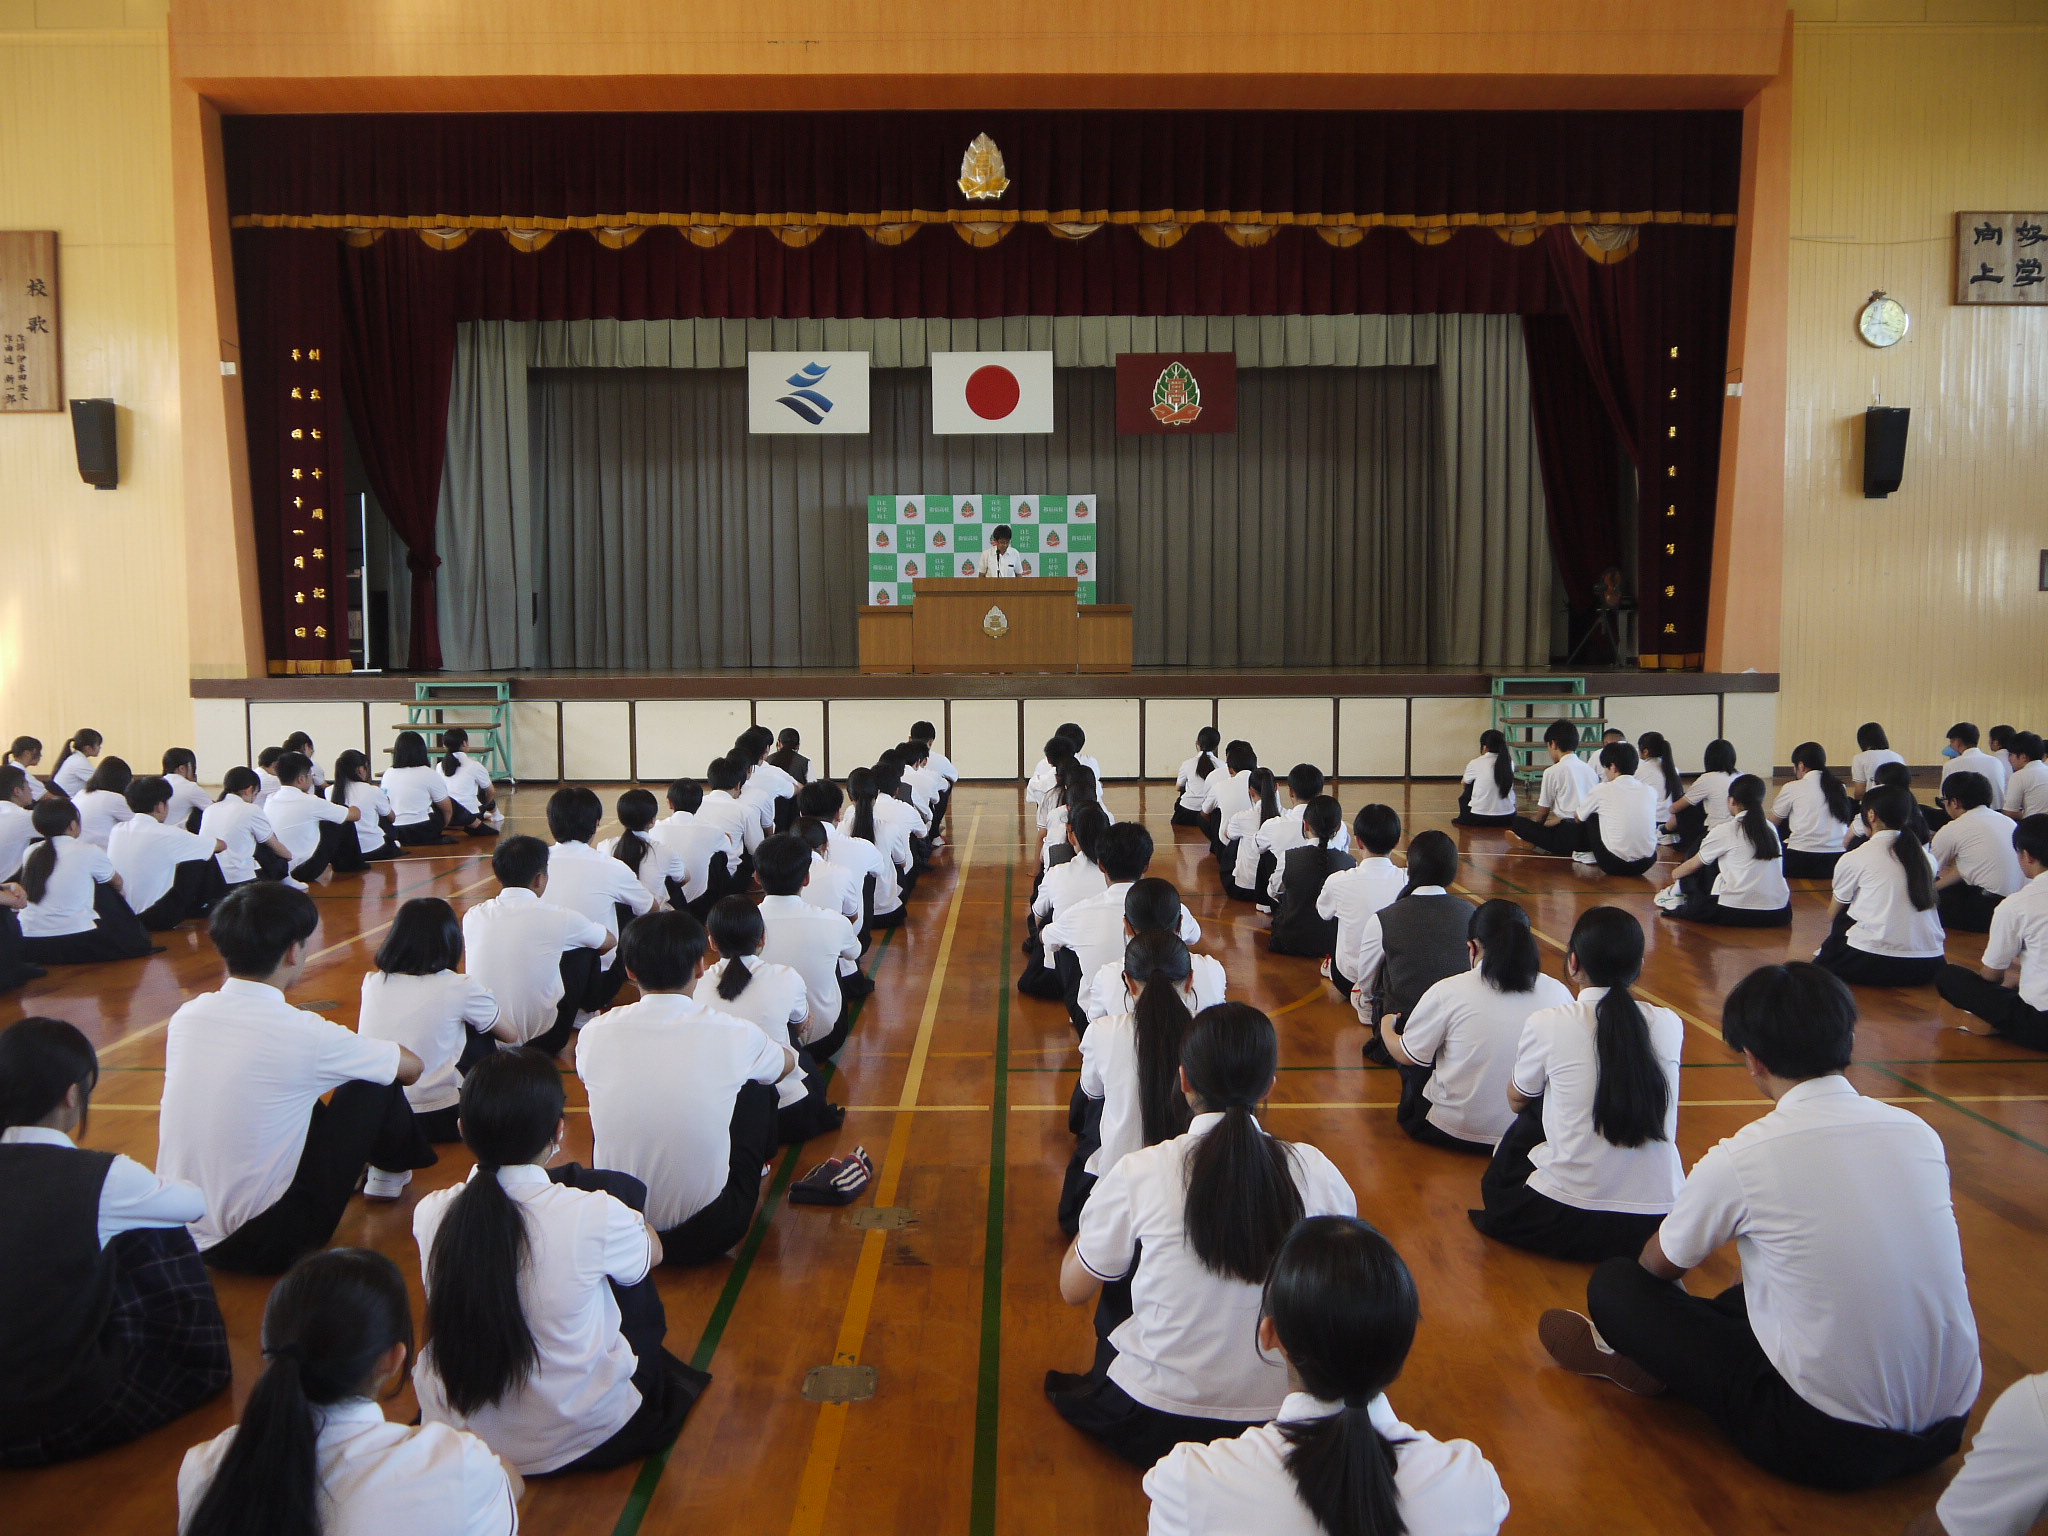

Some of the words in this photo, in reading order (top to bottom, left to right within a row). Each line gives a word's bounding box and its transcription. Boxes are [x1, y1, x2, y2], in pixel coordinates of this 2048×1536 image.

[26, 278, 49, 334] 校歌
[1970, 221, 2005, 284] 向上
[290, 348, 307, 638] 平成四年十一月吉日
[308, 348, 327, 638] 創立七十周年記念
